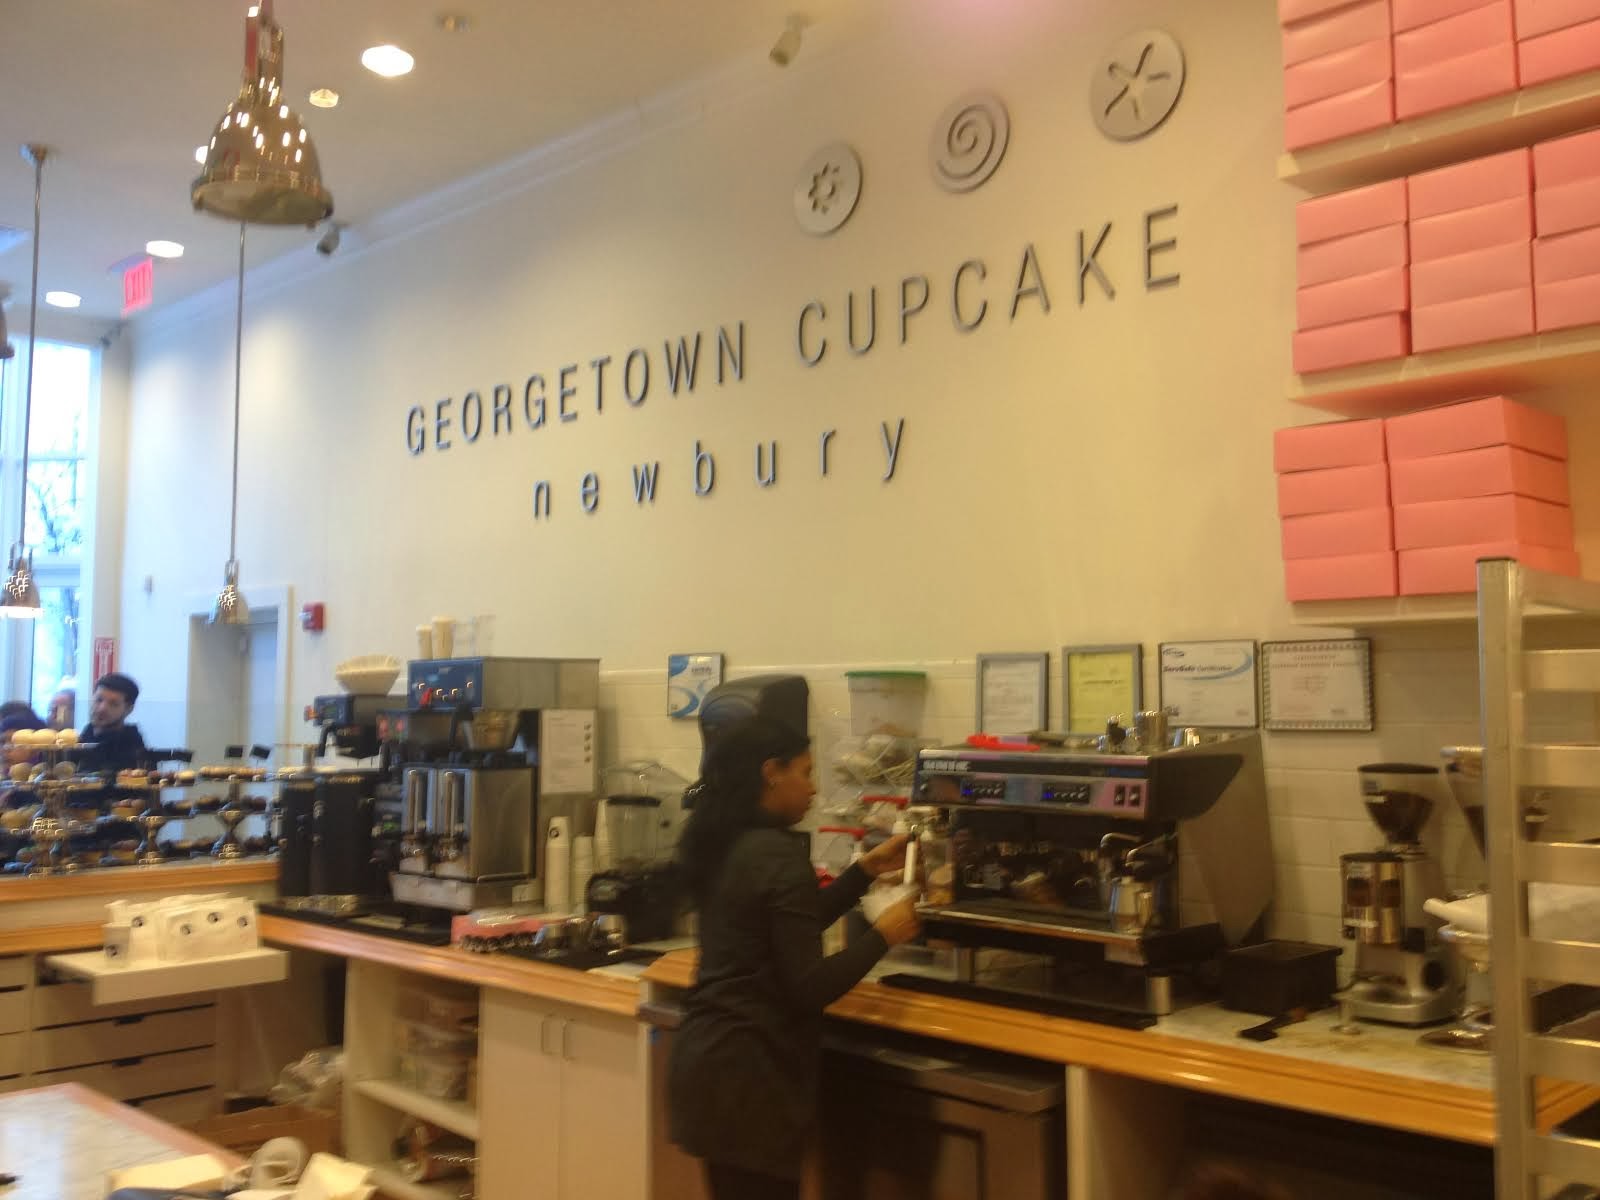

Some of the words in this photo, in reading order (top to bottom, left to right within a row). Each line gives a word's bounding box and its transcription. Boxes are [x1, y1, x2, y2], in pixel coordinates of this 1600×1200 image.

[406, 320, 745, 456] GEORGETOWN
[797, 203, 1181, 367] CUPCAKE
[533, 417, 906, 520] newbury
